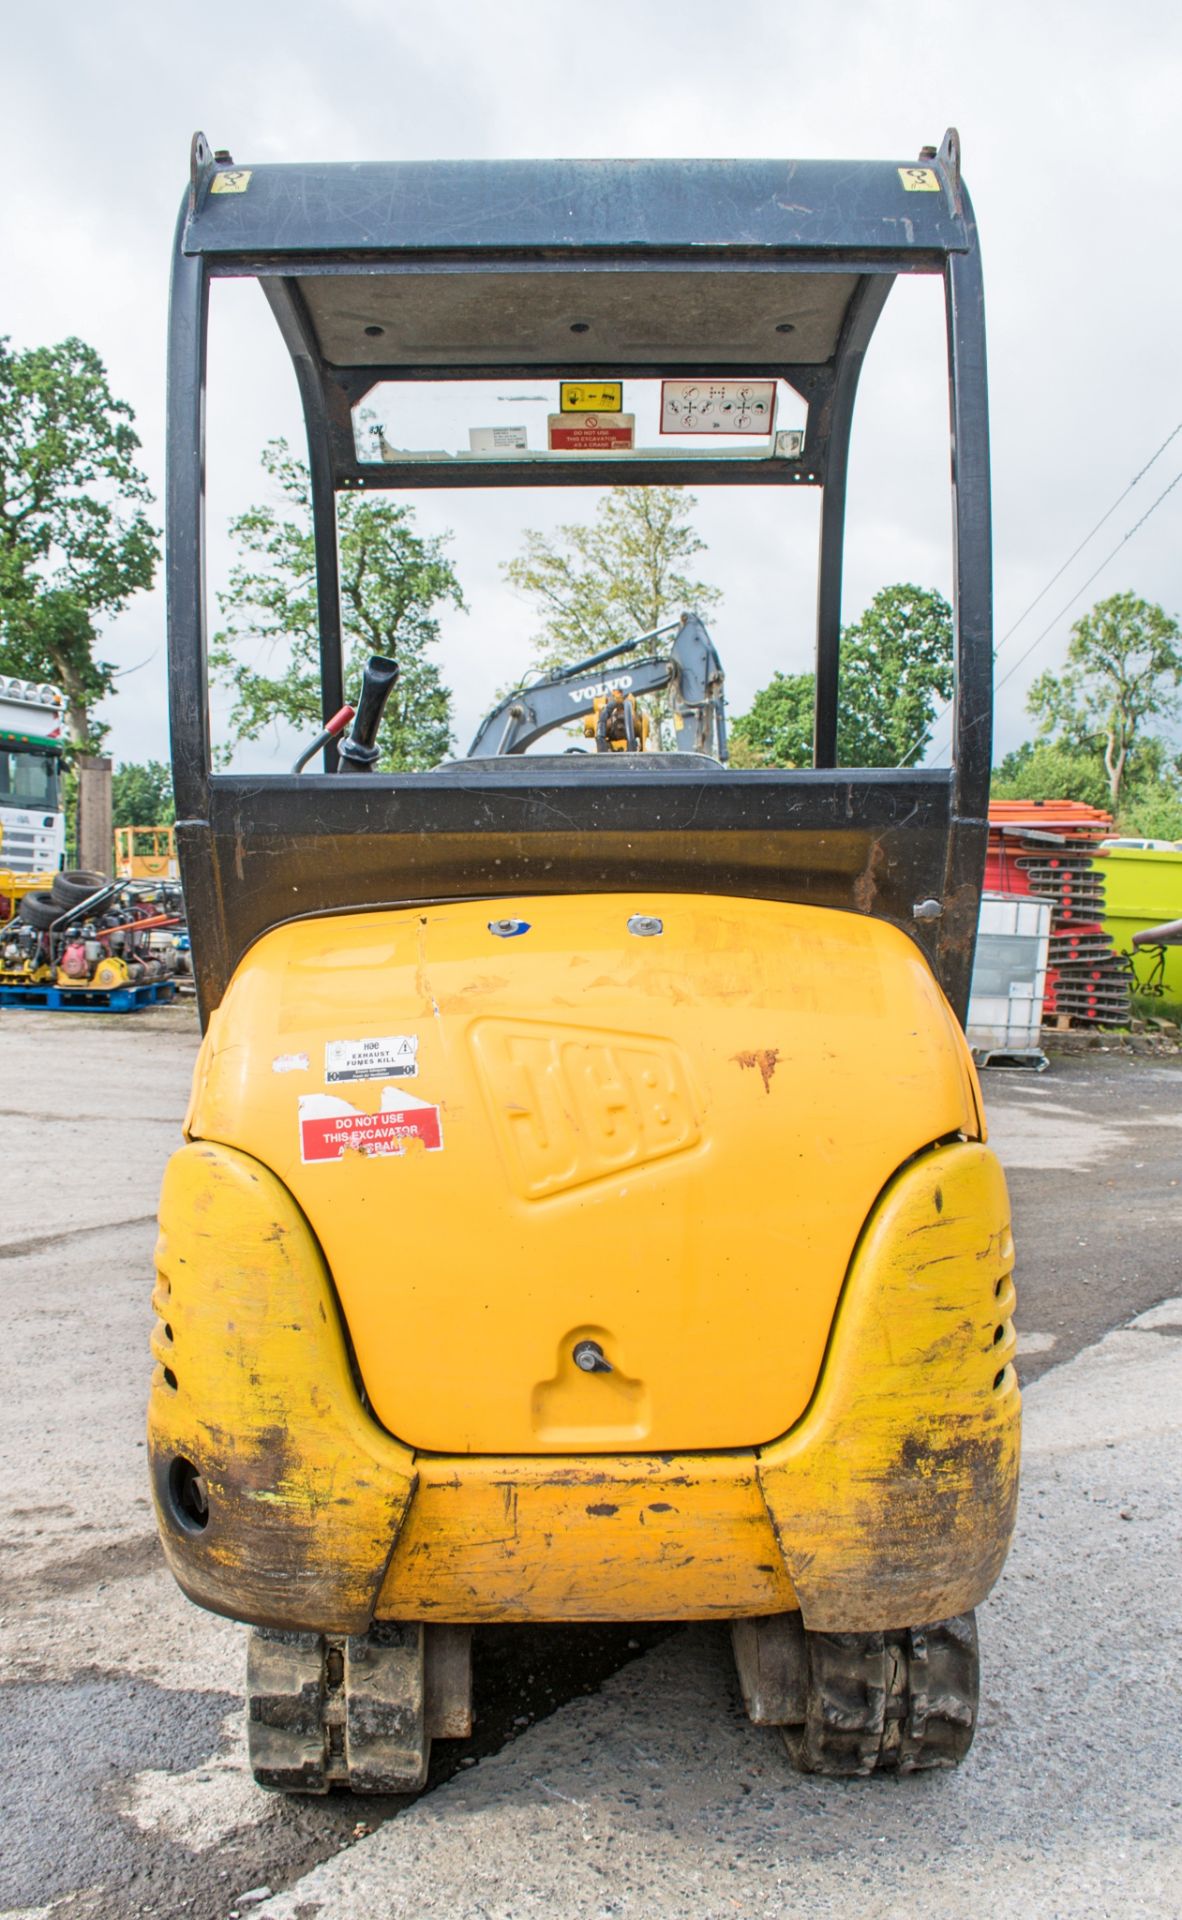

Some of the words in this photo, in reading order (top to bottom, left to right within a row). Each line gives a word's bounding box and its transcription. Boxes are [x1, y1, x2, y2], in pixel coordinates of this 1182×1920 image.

[568, 675, 633, 703] VOLVO
[346, 1058, 375, 1067] FUMES
[377, 1056, 396, 1064] KILL
[352, 1050, 390, 1059] EXHAUST
[335, 1119, 353, 1130] DO
[355, 1115, 379, 1128] NOT
[381, 1113, 405, 1125] USE
[323, 1131, 349, 1144] THIS
[351, 1124, 419, 1141] EXCAVATOR
